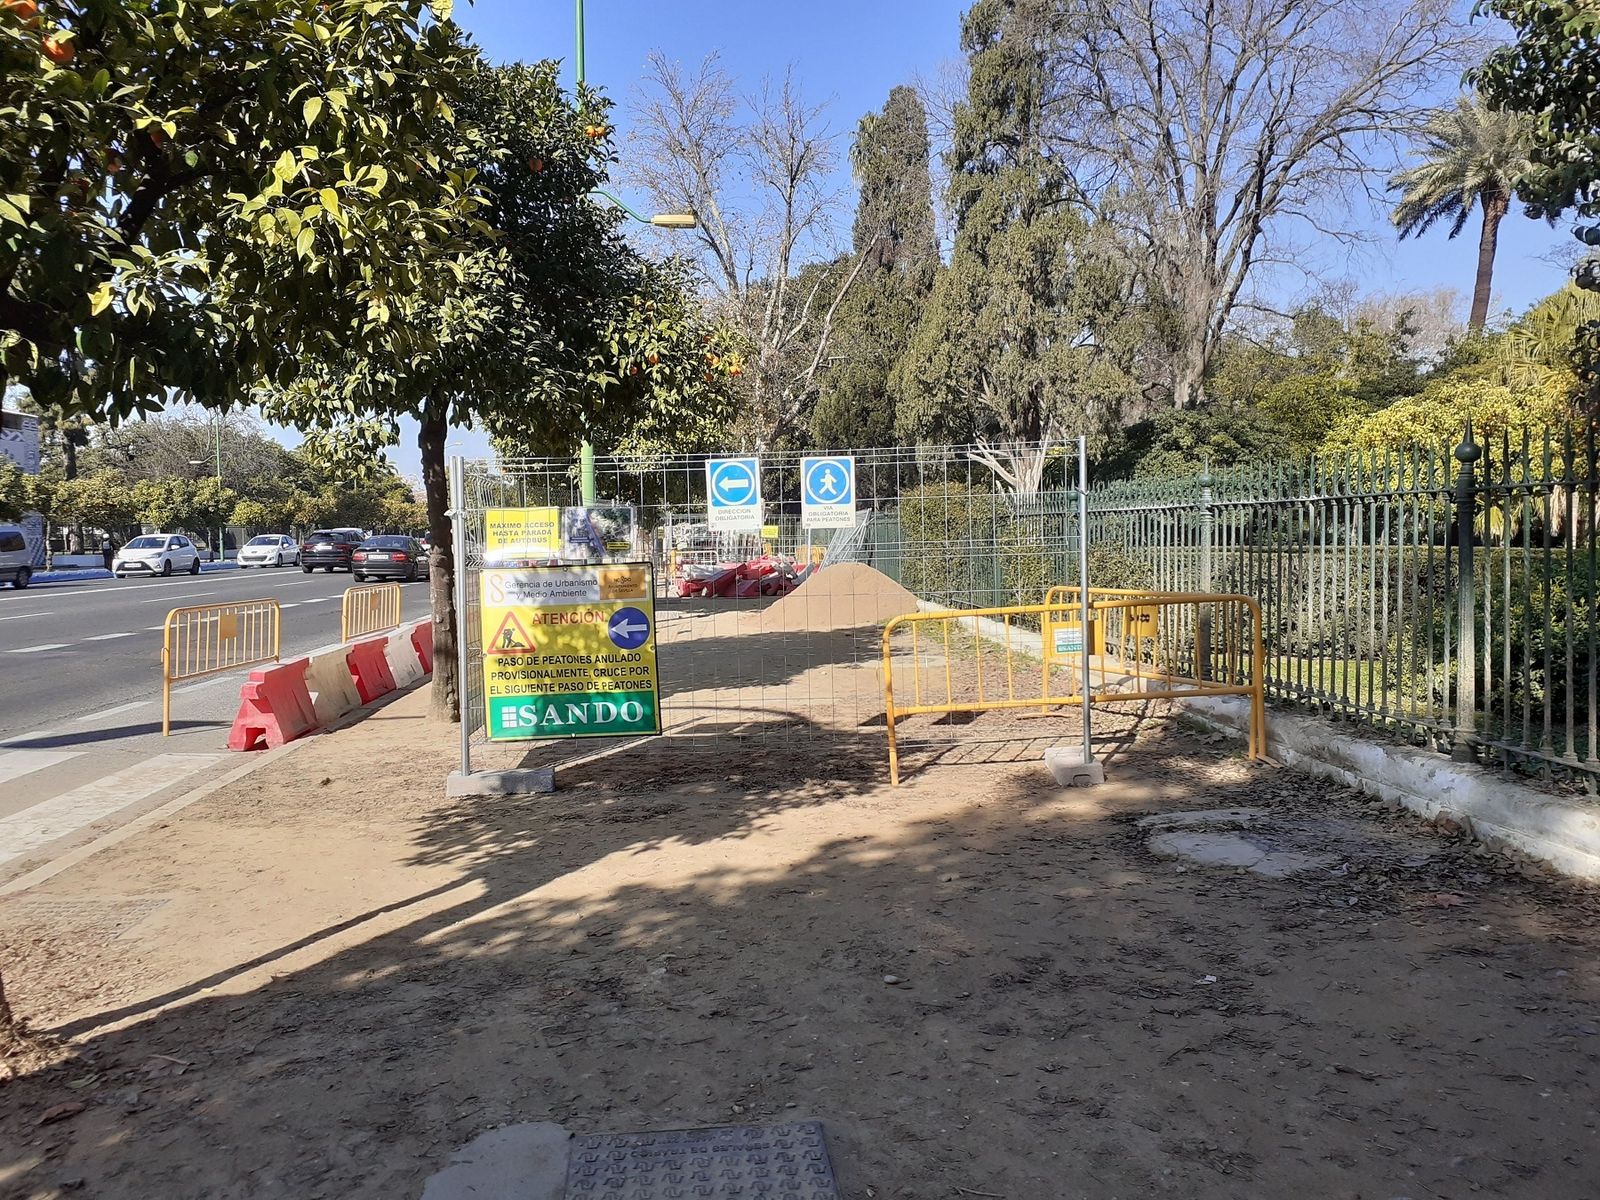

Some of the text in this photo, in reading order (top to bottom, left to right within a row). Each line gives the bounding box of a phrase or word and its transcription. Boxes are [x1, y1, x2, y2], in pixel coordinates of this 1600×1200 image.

[714, 514, 755, 522] OBLIGATORIA
[525, 521, 555, 529] ACCESO
[492, 528, 552, 537] HASTA PARADA
[504, 578, 598, 589] Gerencia de Urbanismo
[516, 589, 587, 600] y Medio Ambiente
[532, 608, 606, 625] ATENCIÓN
[497, 653, 641, 667] PASO DE PEATONES ANULADO
[491, 666, 650, 681] PROVISIONALMENTE, CRUCE POR
[490, 679, 652, 695] EL SIGUIENTE PASO DE PEATONES
[518, 700, 644, 727] SANDO
